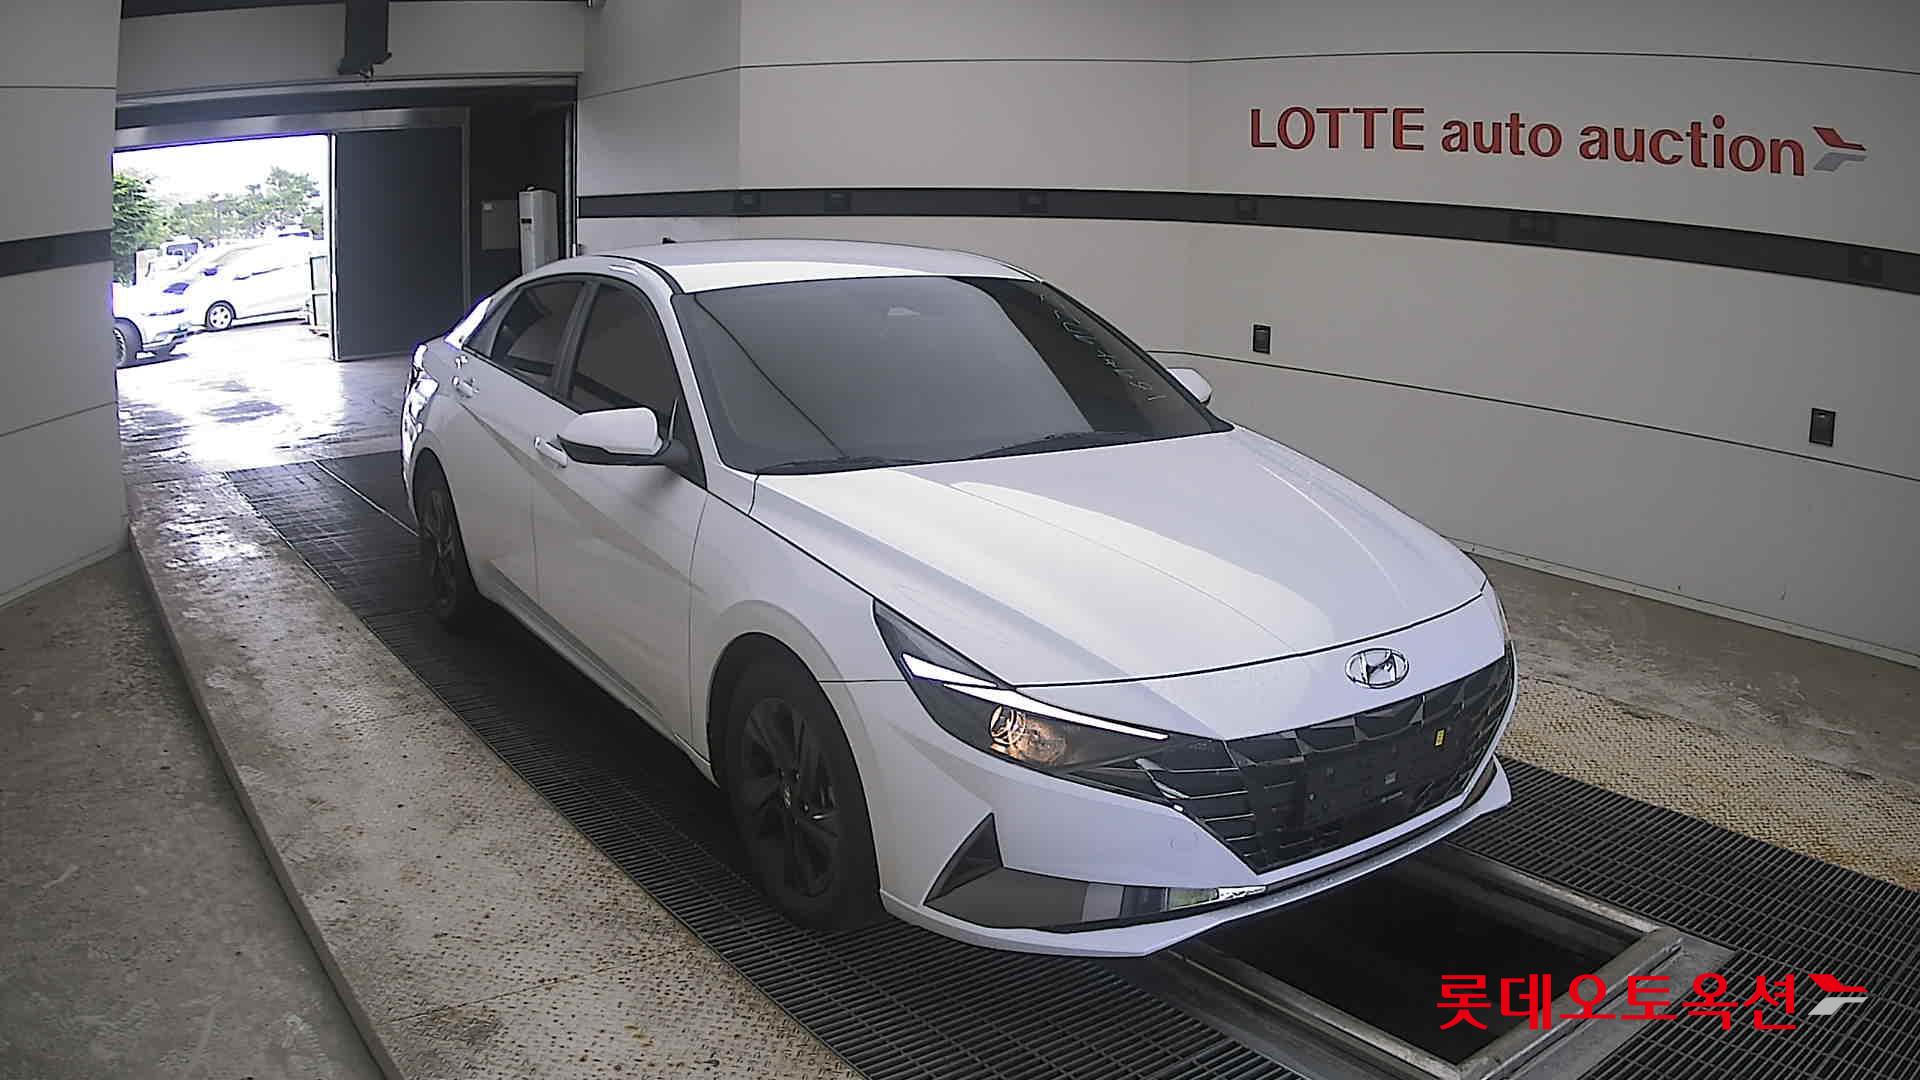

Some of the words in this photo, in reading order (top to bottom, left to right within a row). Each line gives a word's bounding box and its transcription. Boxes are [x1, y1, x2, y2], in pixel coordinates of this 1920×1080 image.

[1250, 106, 1425, 151] LOTTE
[1441, 112, 1562, 159] auto
[1579, 115, 1806, 177] auction
